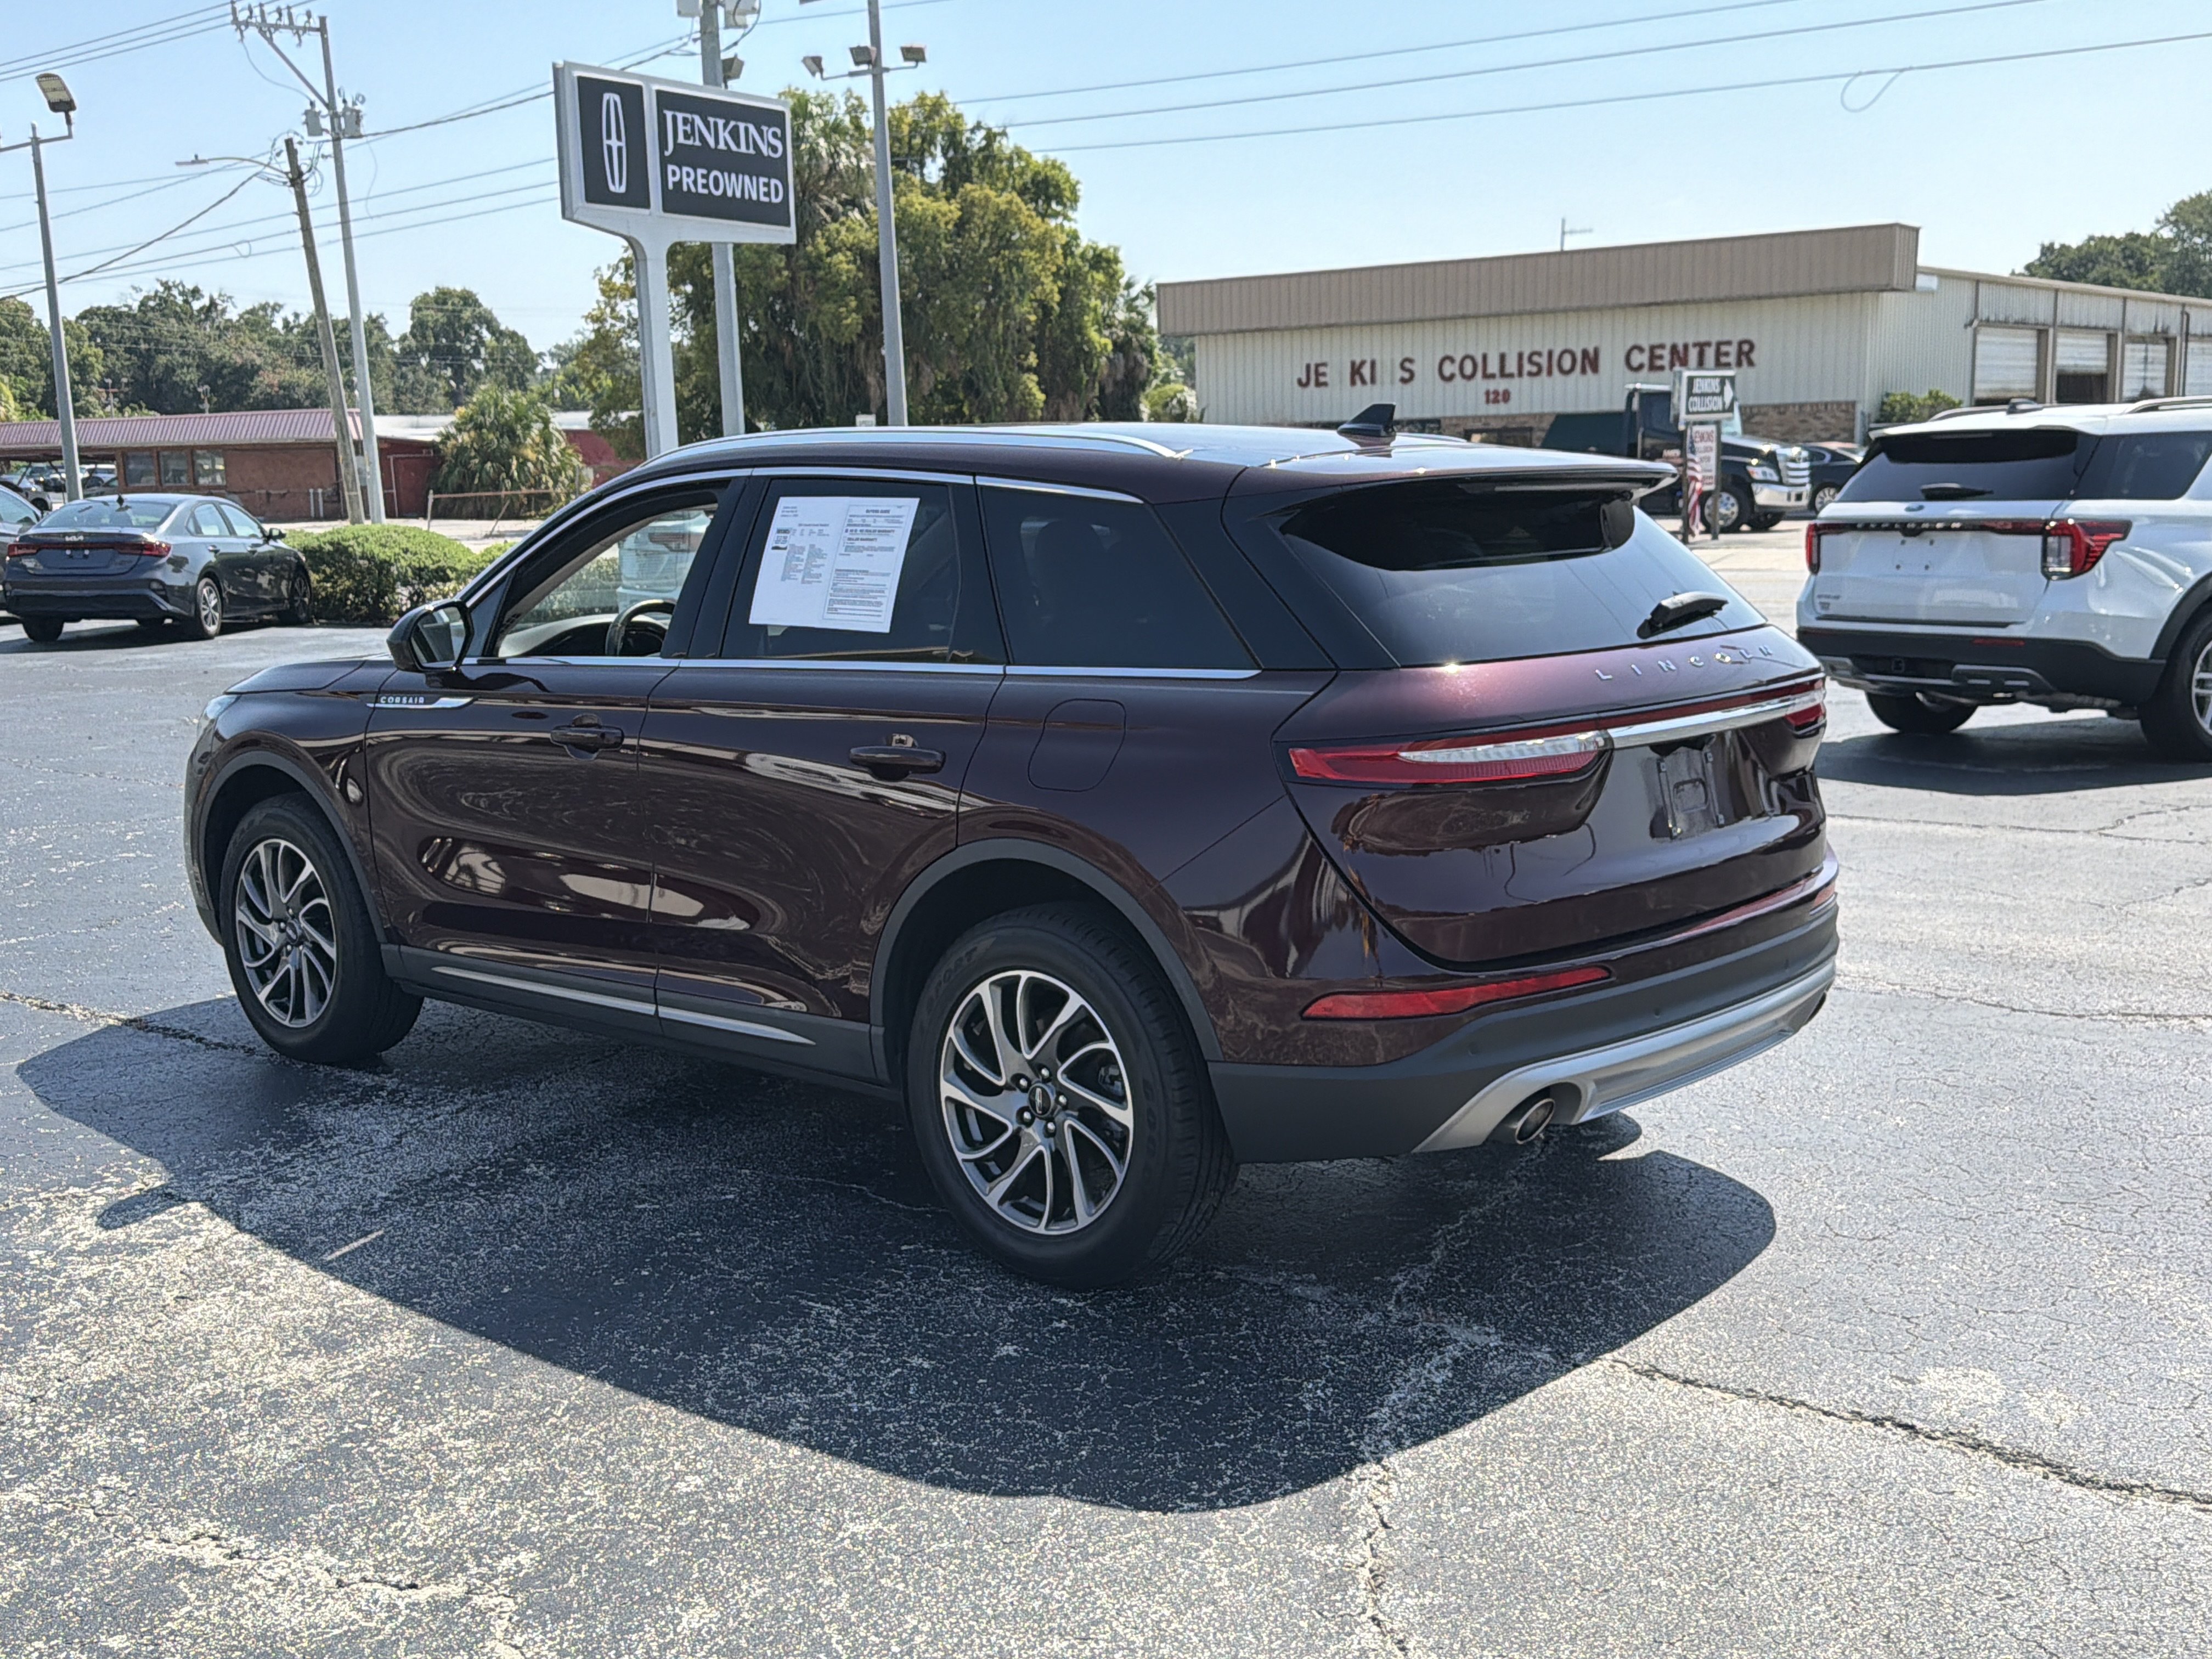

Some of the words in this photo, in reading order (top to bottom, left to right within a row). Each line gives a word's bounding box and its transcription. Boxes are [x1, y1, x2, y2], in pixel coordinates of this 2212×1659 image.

[663, 109, 783, 159] JENKINS
[667, 164, 783, 204] PREOWNED
[1437, 346, 1600, 382] COLLISION
[1624, 338, 1756, 373] CENTER
[1484, 388, 1511, 405] 120
[1692, 377, 1721, 394] JENKINS
[1688, 395, 1723, 413] COLLISION
[1595, 644, 1773, 680] LINCOLN
